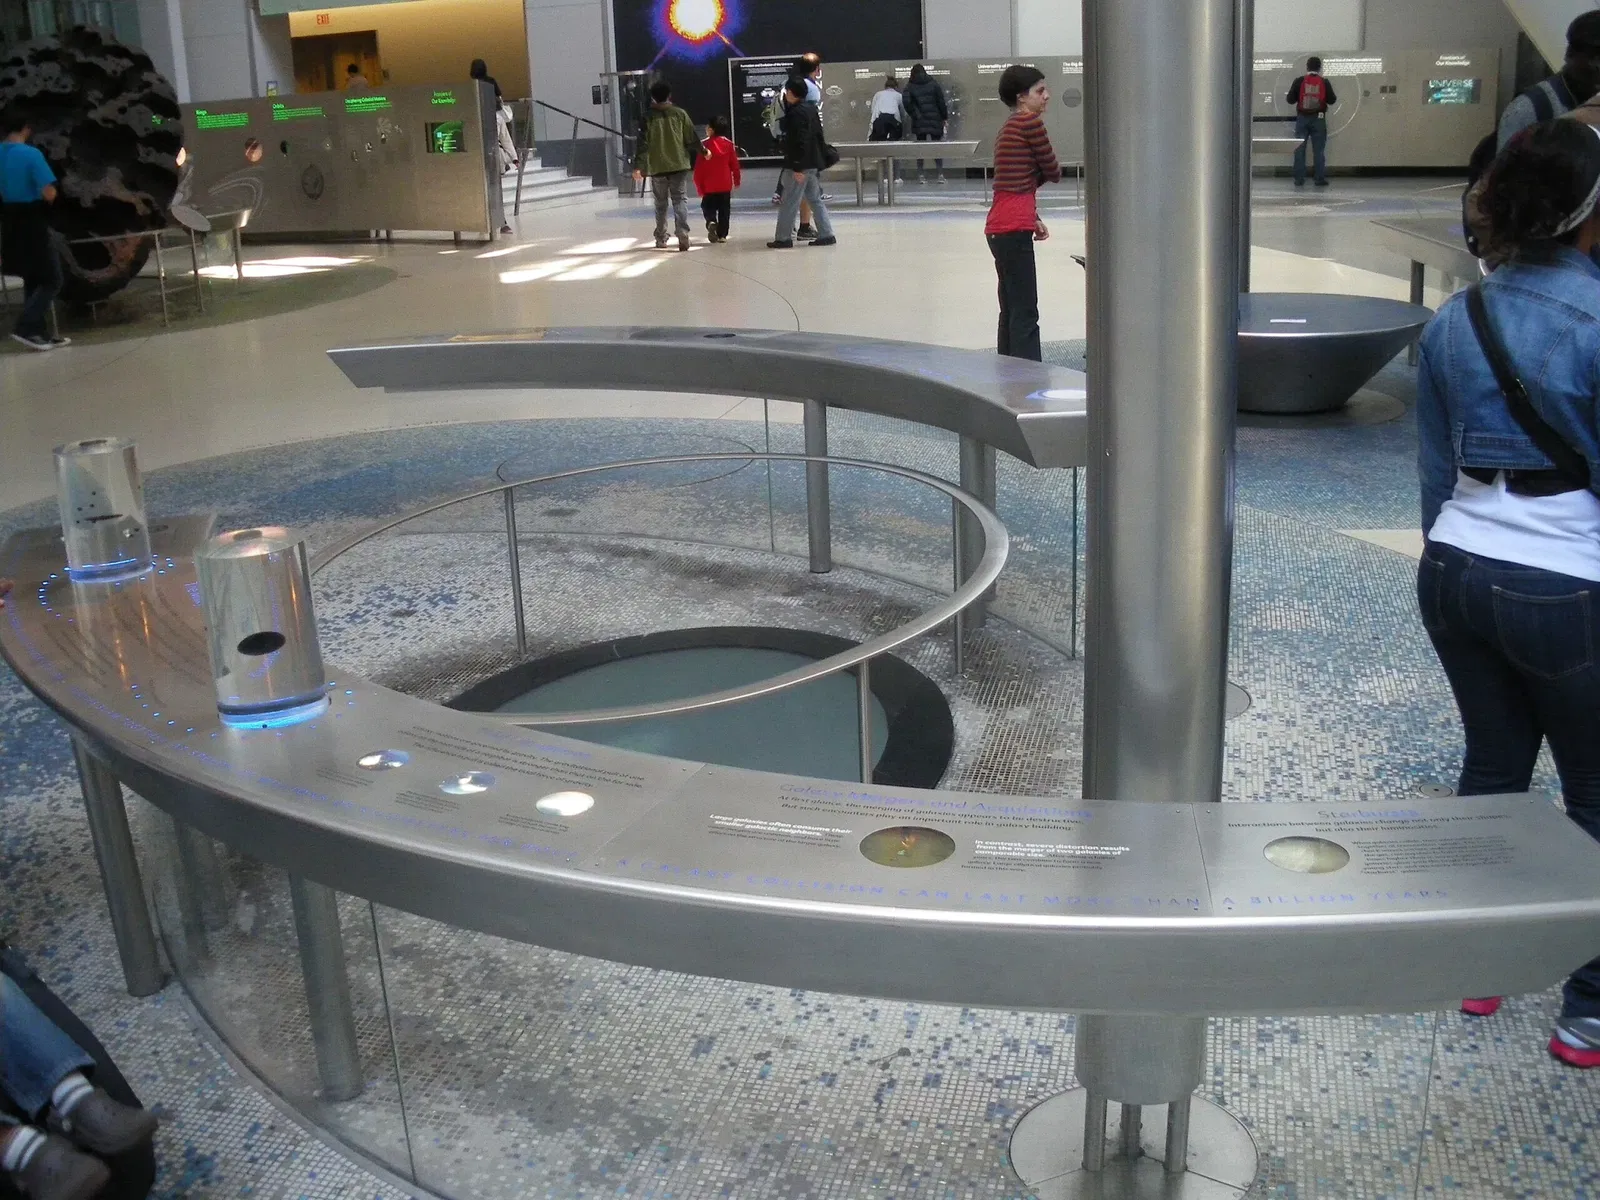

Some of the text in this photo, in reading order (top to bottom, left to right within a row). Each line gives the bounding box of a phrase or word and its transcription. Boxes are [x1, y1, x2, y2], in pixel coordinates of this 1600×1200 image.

[316, 14, 329, 25] EXIT
[1429, 79, 1473, 88] UNIVERSE
[862, 802, 902, 813] merging
[916, 807, 956, 818] galaxies
[957, 813, 997, 821] appears
[930, 801, 967, 810] and
[800, 804, 820, 812] such
[822, 806, 874, 817] encounters
[875, 812, 896, 821] play
[912, 815, 961, 826] important
[996, 821, 1030, 830] galaxy
[1333, 819, 1374, 827] galaxies
[1375, 817, 1410, 826] change
[1428, 815, 1450, 824] only
[710, 813, 852, 834] Large galaxies often consume their
[714, 818, 743, 828] smaller
[744, 822, 778, 834] galactic
[779, 826, 822, 839] neighbors.
[984, 839, 1024, 849] contrast,
[1074, 848, 1112, 856] galaxies
[899, 889, 948, 900] CAN
[964, 892, 1026, 903] LAST
[1250, 892, 1354, 904] BILLION
[1370, 890, 1448, 900] YEARS
